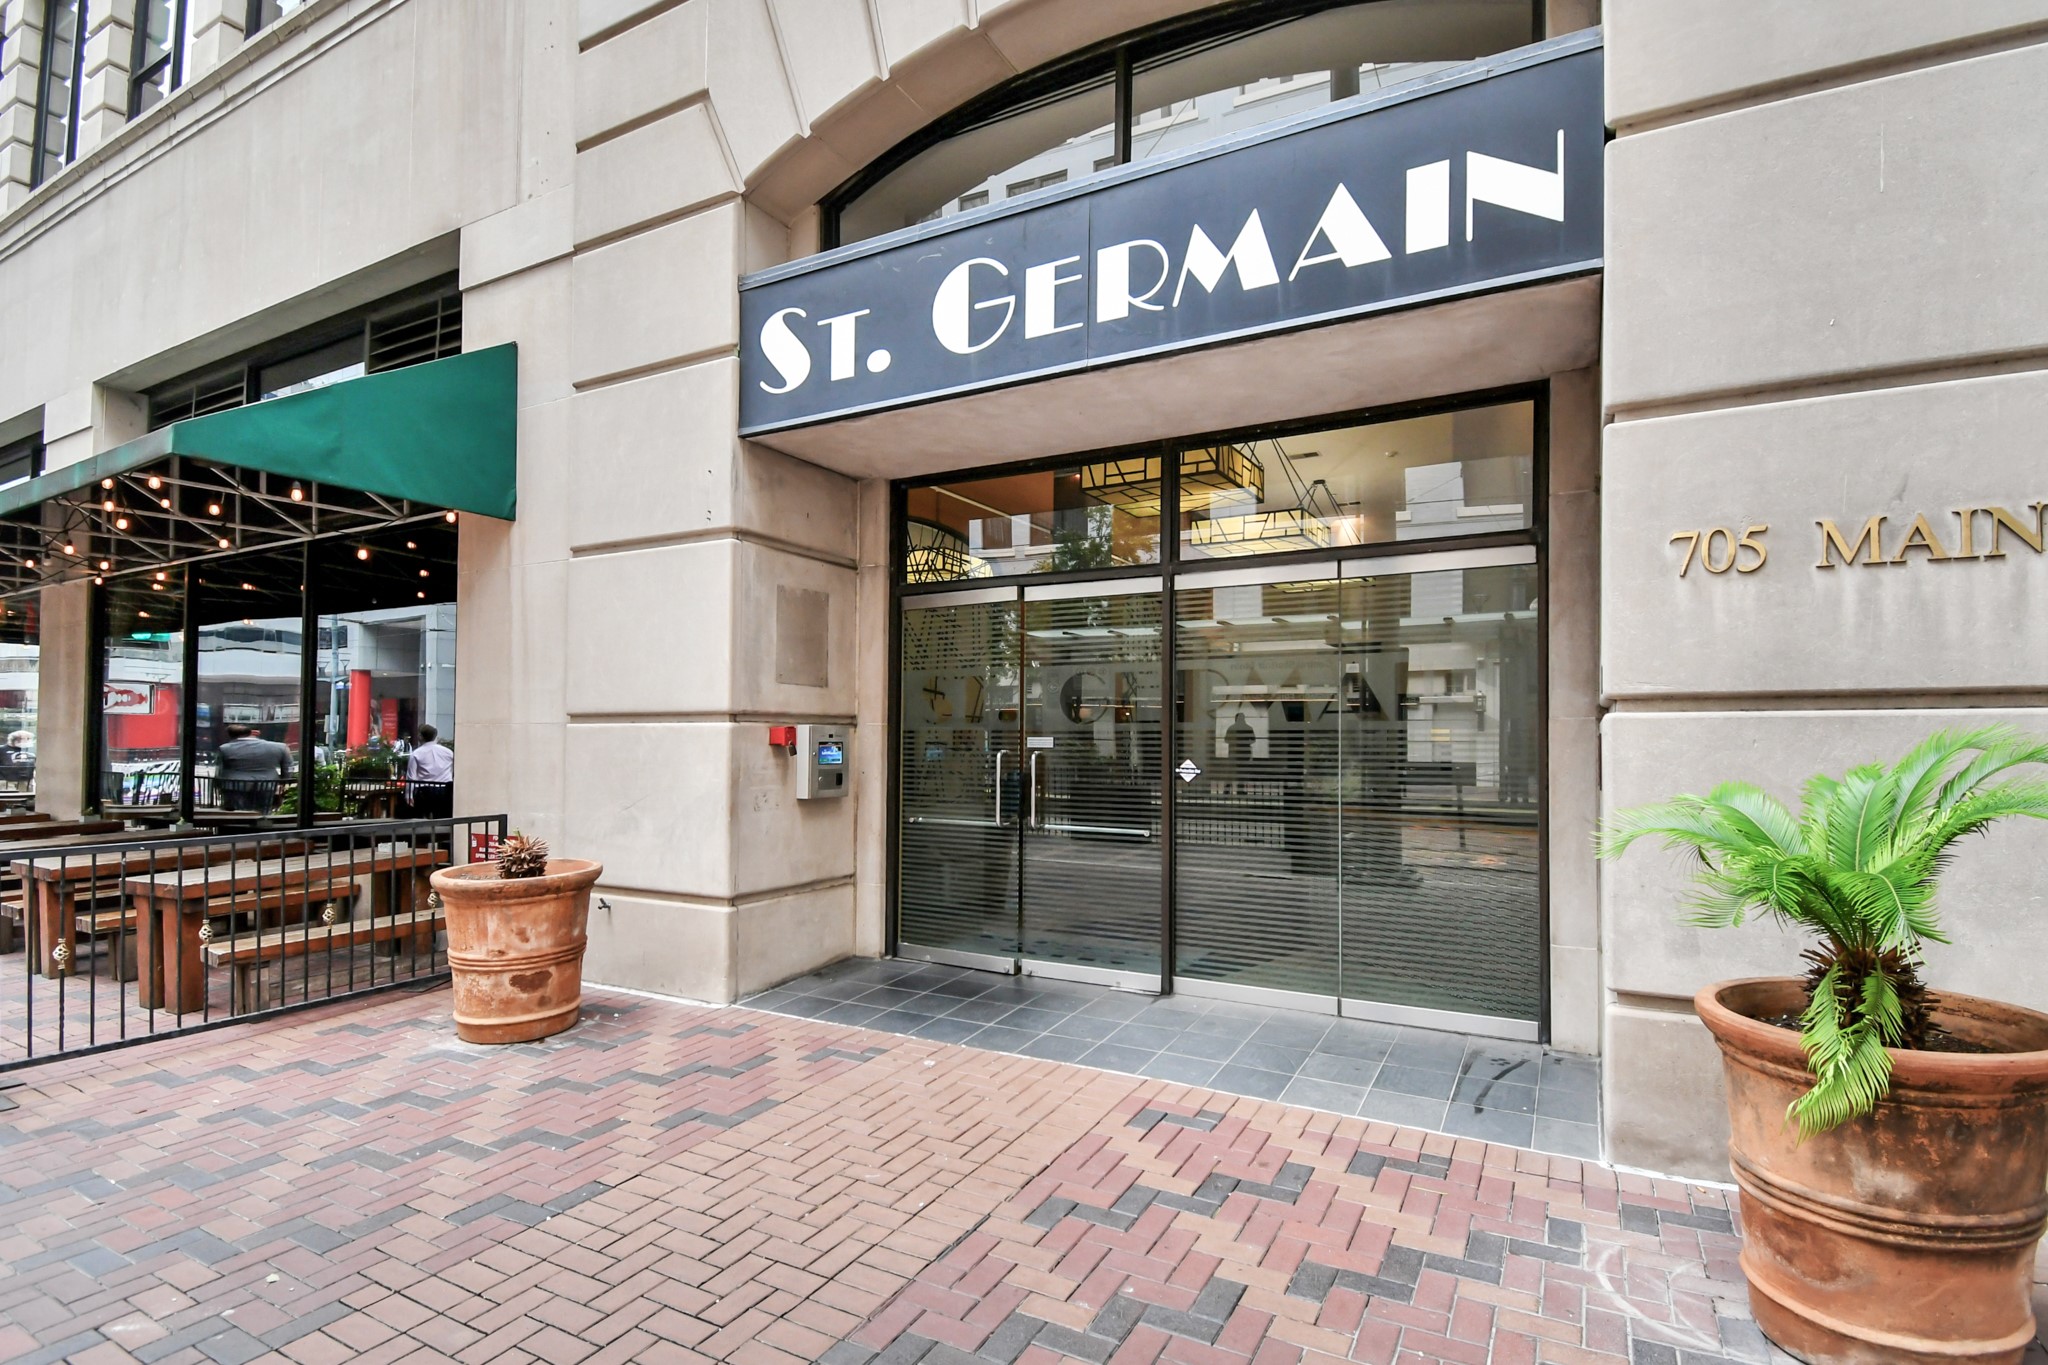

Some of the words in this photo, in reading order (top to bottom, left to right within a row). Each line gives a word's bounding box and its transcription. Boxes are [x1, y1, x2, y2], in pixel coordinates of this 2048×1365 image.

[759, 307, 892, 395] ST.
[931, 128, 1565, 355] GERMAIN
[1669, 525, 1770, 578] 705
[1814, 500, 2048, 569] MAIN
